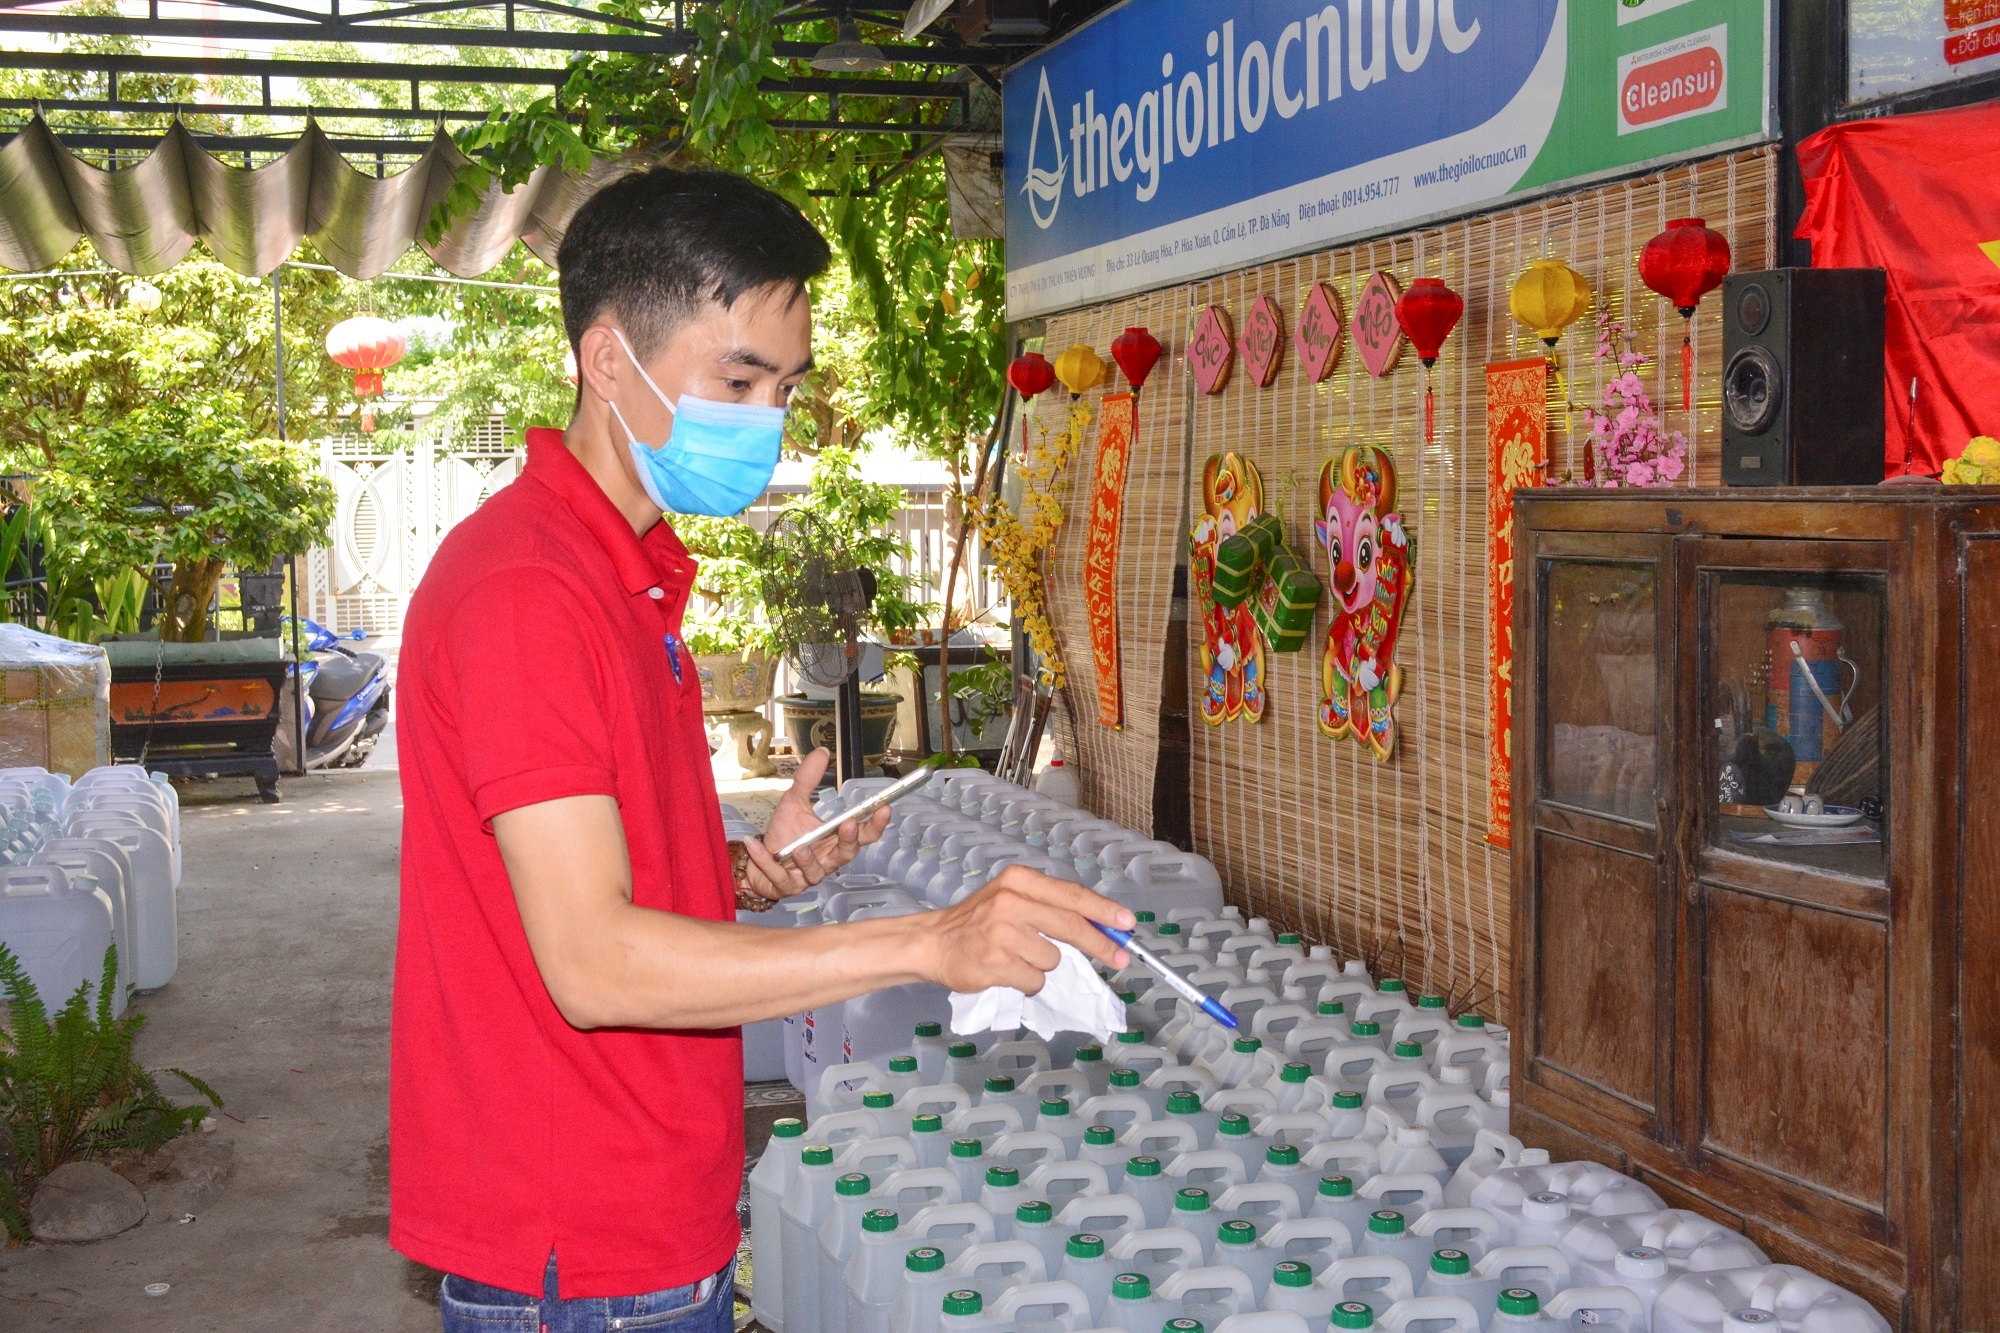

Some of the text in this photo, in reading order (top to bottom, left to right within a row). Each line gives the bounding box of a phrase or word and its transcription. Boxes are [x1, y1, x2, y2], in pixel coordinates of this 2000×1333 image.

[1959, 7, 1981, 23] trên
[1662, 43, 1685, 54] CHEMICAL
[1687, 34, 1711, 46] CLEANSUI
[1959, 36, 1979, 54] Đạt
[1626, 60, 1715, 112] Cleansui
[1107, 259, 1115, 275] Địa
[1126, 253, 1134, 268] 33
[1134, 250, 1141, 266] Lê
[1174, 240, 1181, 255] P.
[1194, 233, 1212, 250] Xuân,
[1213, 229, 1221, 245] Q.
[1221, 222, 1236, 241] Cẩm
[1237, 222, 1248, 241] Lệ,
[1248, 218, 1259, 236] TP.
[1260, 215, 1270, 231] Đà
[1271, 208, 1290, 228] Nẵng
[1299, 204, 1316, 223] Điện
[1318, 198, 1340, 216] thoại:
[1342, 177, 1399, 207] 0914.954.777
[1413, 144, 1527, 188] www.thegioilocnuoc.vn
